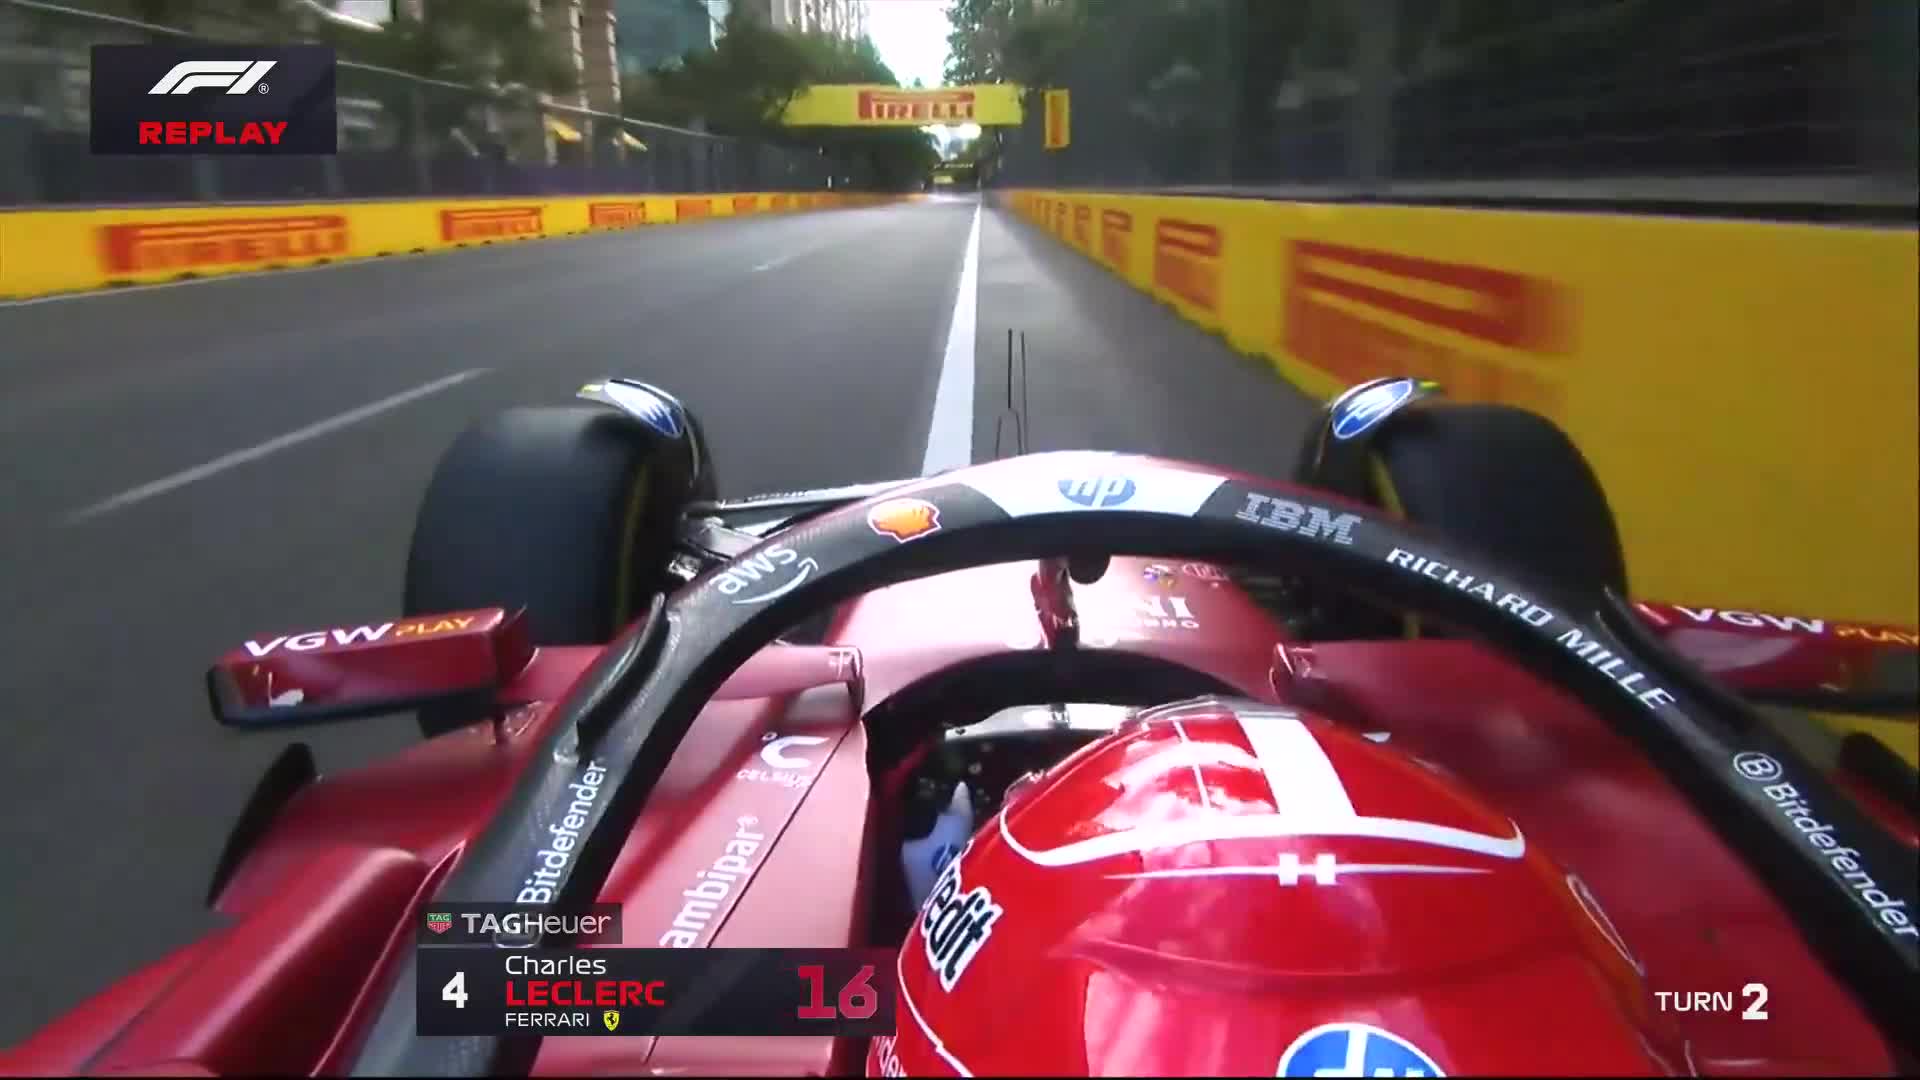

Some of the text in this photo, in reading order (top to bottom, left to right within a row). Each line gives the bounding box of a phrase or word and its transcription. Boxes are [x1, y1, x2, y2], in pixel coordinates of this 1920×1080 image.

[1235, 492, 1362, 545] IBM
[709, 543, 797, 594] aws
[245, 617, 474, 657] VGW PLAY
[1386, 548, 1676, 710] RICHARD MILLE
[1672, 604, 1824, 633] VGW
[516, 761, 607, 904] Bitdefender
[1763, 782, 1919, 937] Bitdefender
